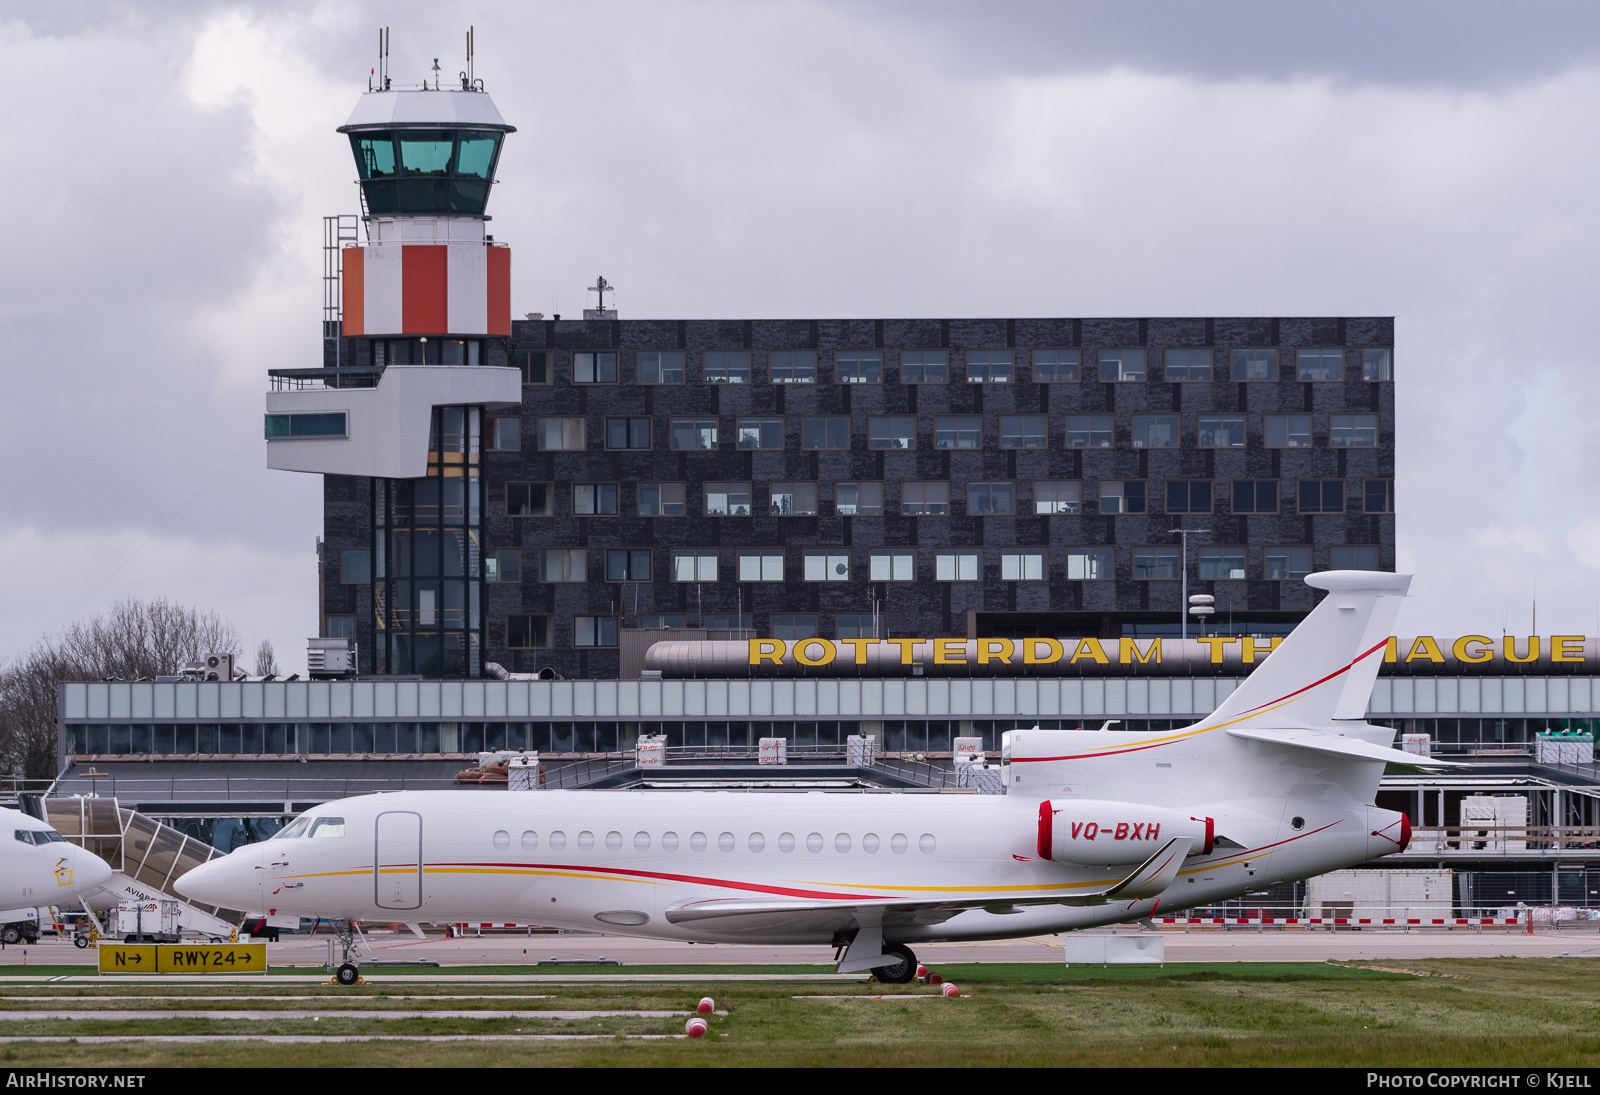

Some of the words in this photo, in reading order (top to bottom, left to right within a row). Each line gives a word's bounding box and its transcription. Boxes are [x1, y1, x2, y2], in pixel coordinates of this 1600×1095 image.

[748, 637, 1162, 666] ROTTERDAM
[1197, 636, 1284, 664] TH
[1384, 635, 1586, 664] AGUE
[1071, 821, 1161, 841] VQ-BXH
[115, 952, 125, 965] N
